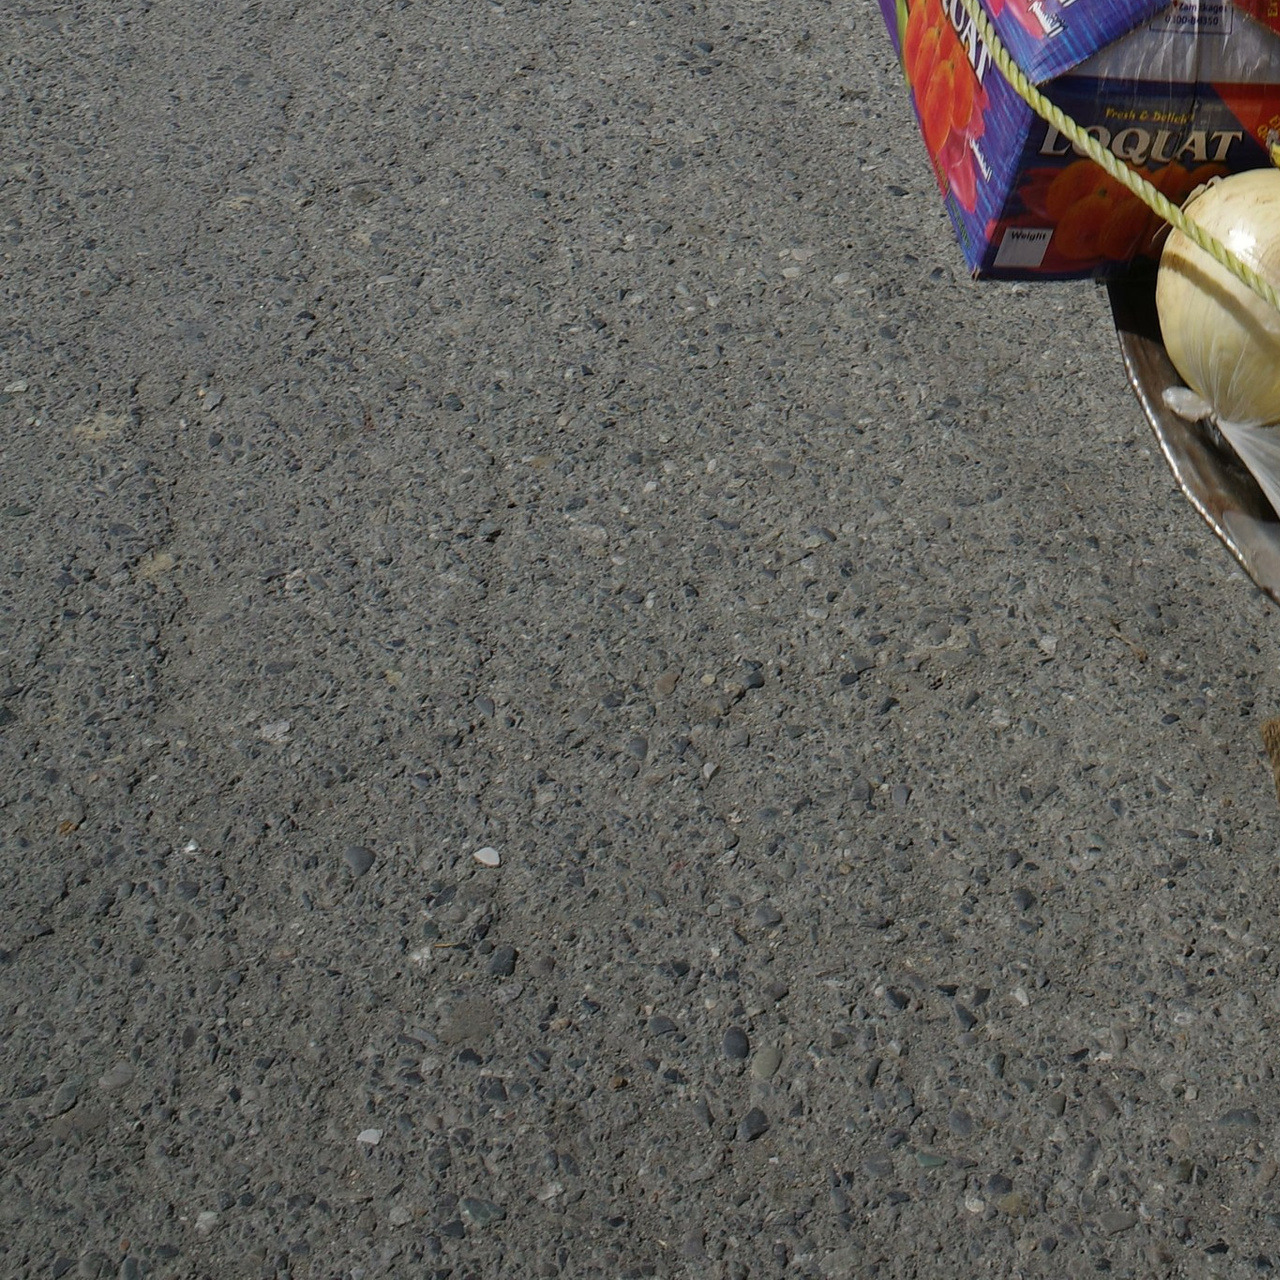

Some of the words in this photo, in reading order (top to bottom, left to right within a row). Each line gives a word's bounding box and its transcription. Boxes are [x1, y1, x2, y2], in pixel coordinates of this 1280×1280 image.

[1104, 106, 1136, 120] Fresh
[1139, 109, 1149, 121] &
[1038, 122, 1244, 167] LOQUAT
[1011, 228, 1047, 242] Weight
